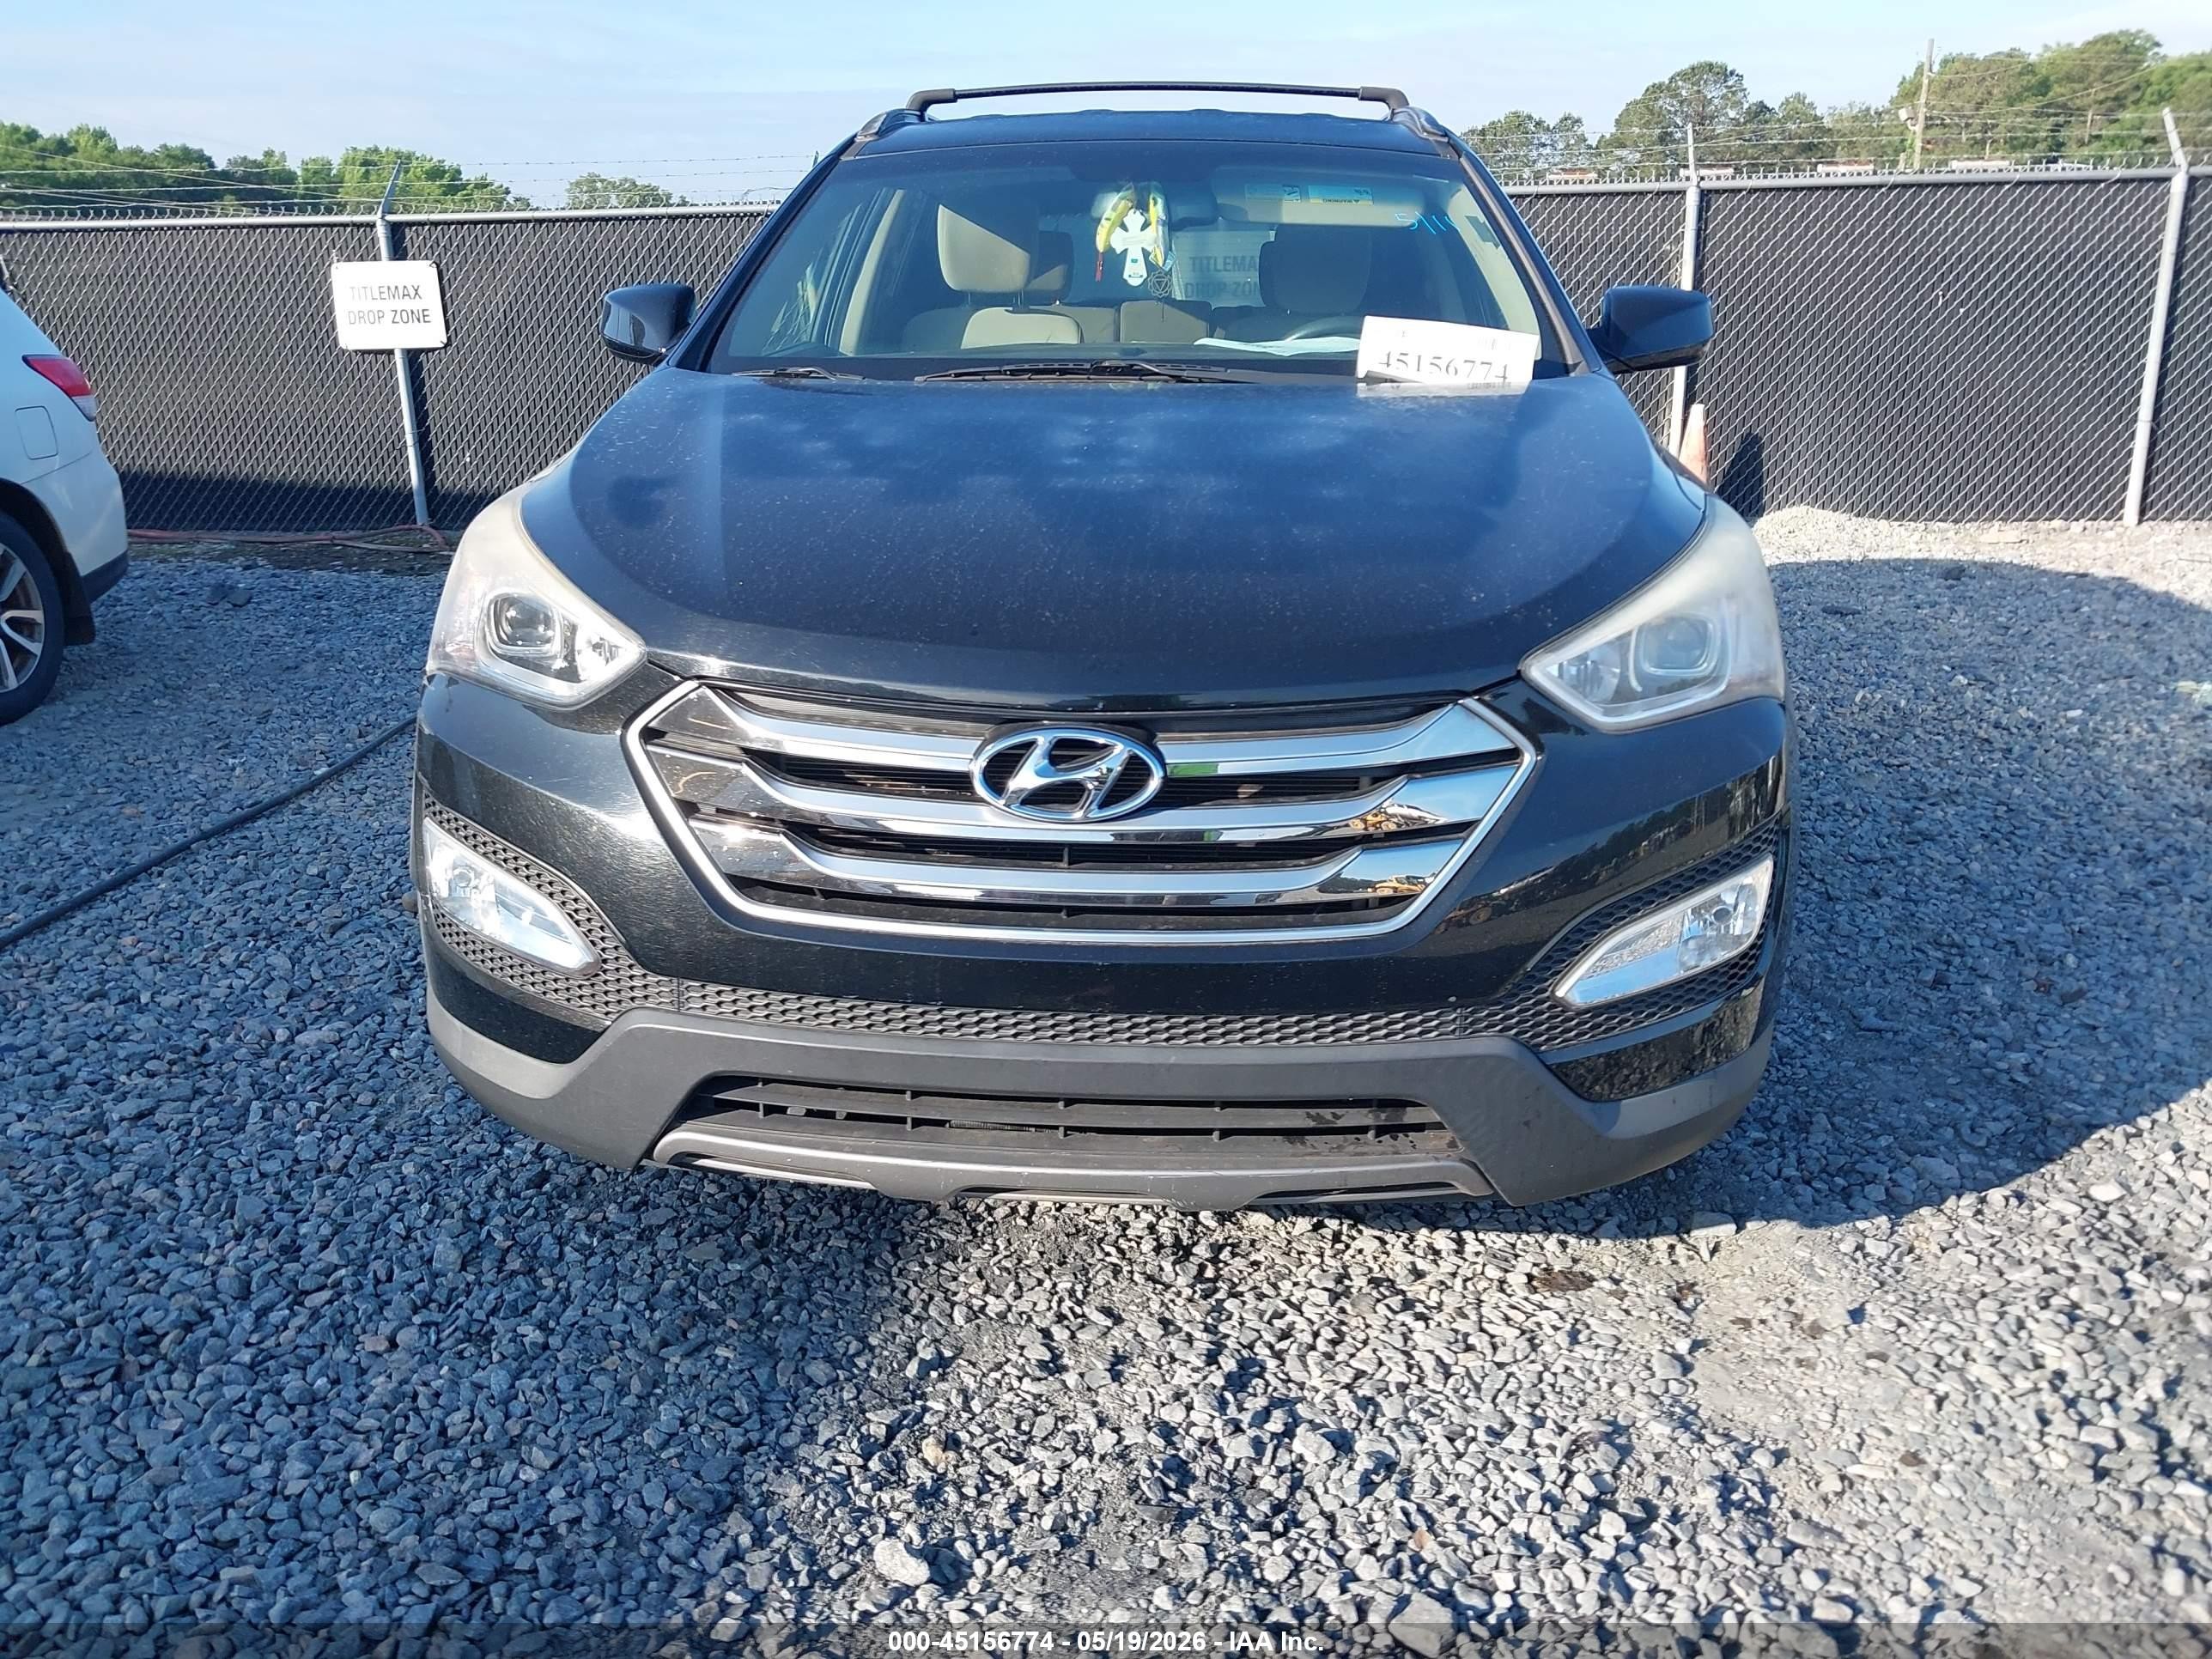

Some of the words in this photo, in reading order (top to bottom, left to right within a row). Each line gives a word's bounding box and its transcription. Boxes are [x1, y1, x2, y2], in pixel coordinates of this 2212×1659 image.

[1188, 256, 1259, 272] TITLEMA
[349, 284, 422, 301] TITLEMAX
[1185, 283, 1226, 298] DROP
[348, 310, 385, 325] DROP
[391, 308, 432, 324] ZONE
[1378, 350, 1509, 383] 45156774
